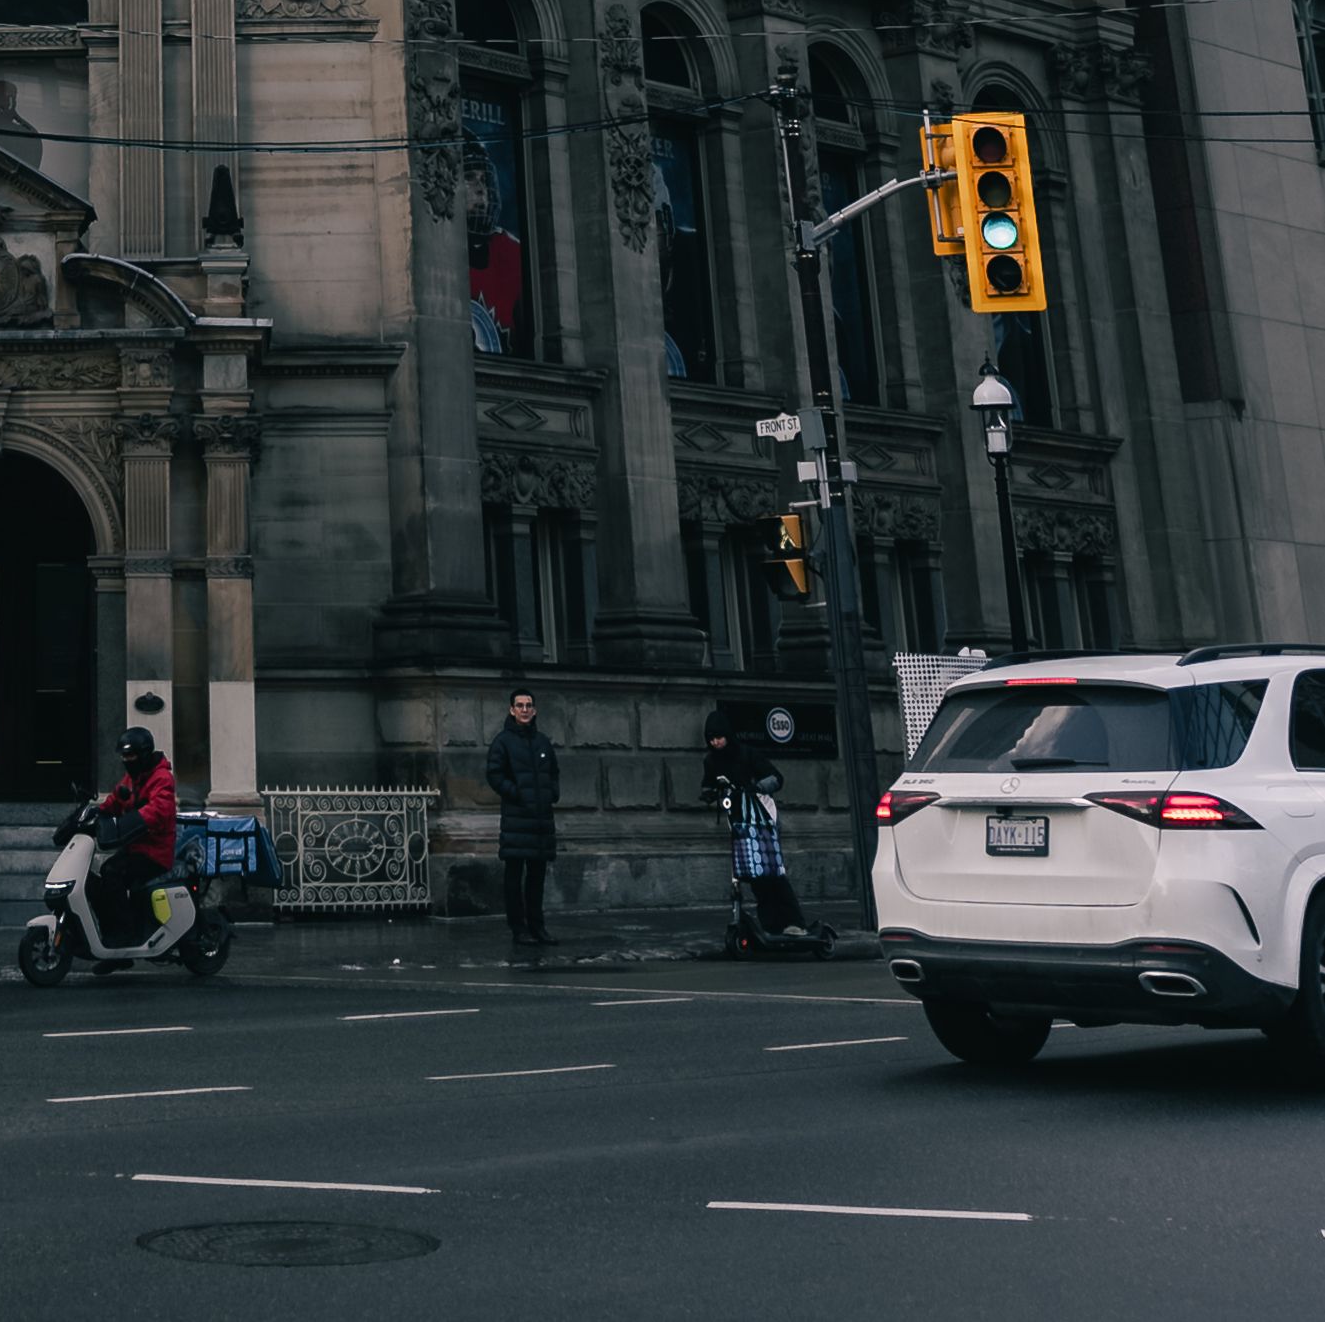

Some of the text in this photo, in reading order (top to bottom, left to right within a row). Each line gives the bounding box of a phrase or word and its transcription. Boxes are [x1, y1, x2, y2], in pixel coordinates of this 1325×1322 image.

[759, 419, 785, 435] FRONT
[772, 717, 790, 732] Esso
[1024, 826, 1045, 845] 115
